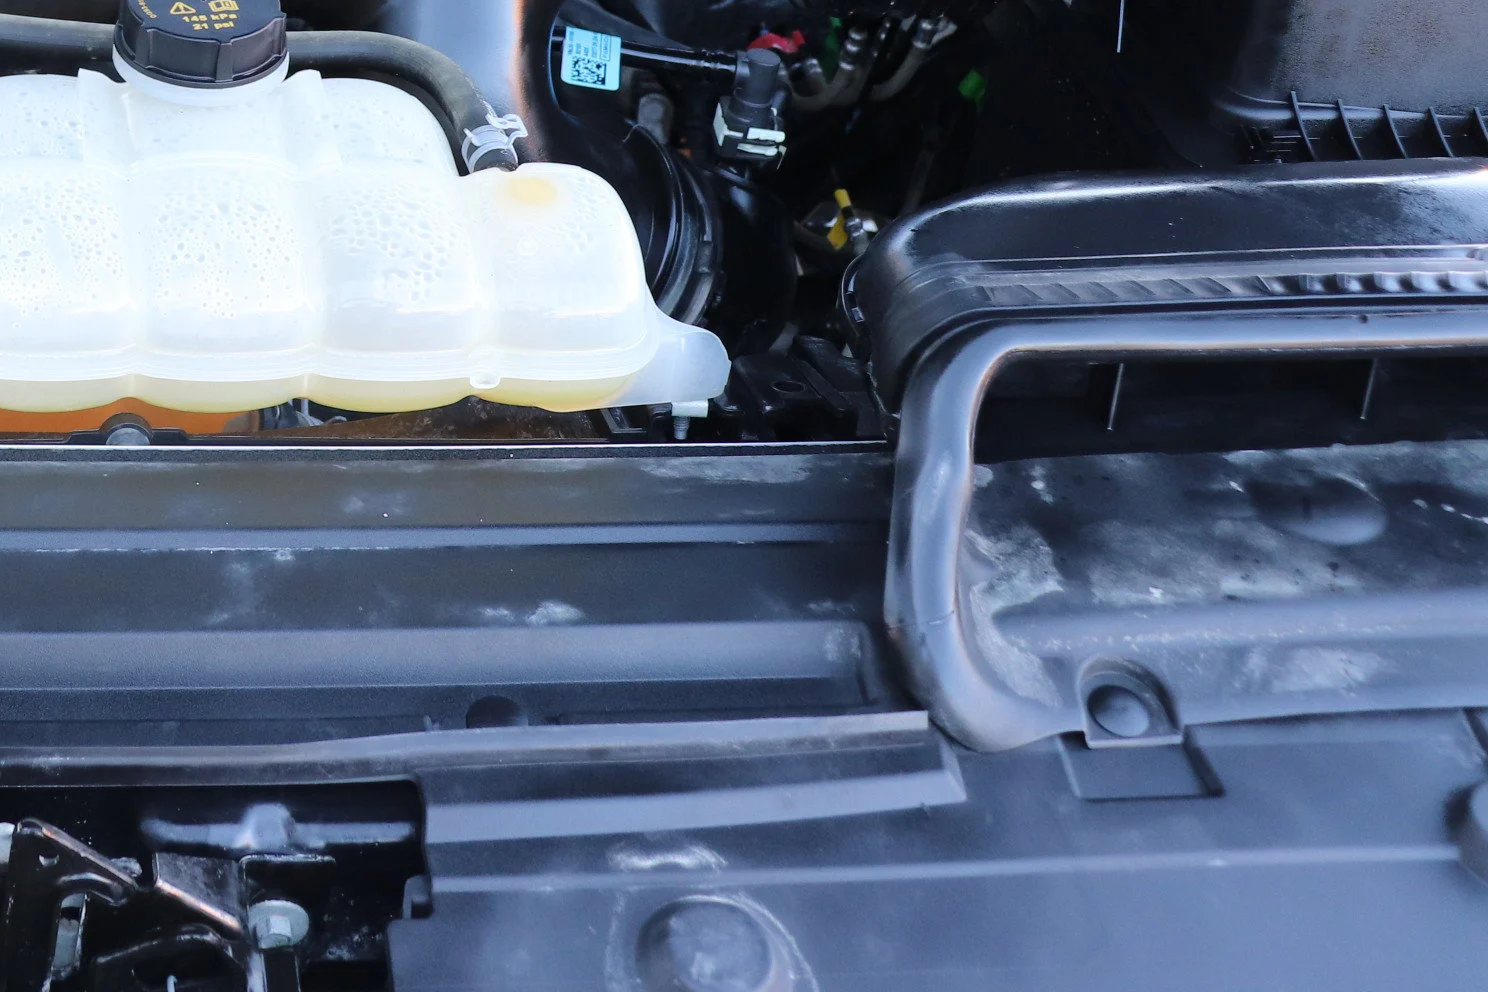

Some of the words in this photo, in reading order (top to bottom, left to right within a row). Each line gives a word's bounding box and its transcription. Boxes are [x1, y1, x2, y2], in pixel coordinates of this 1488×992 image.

[182, 14, 208, 23] 145
[210, 13, 238, 22] kPa
[193, 22, 209, 31] 21
[213, 20, 235, 30] psi
